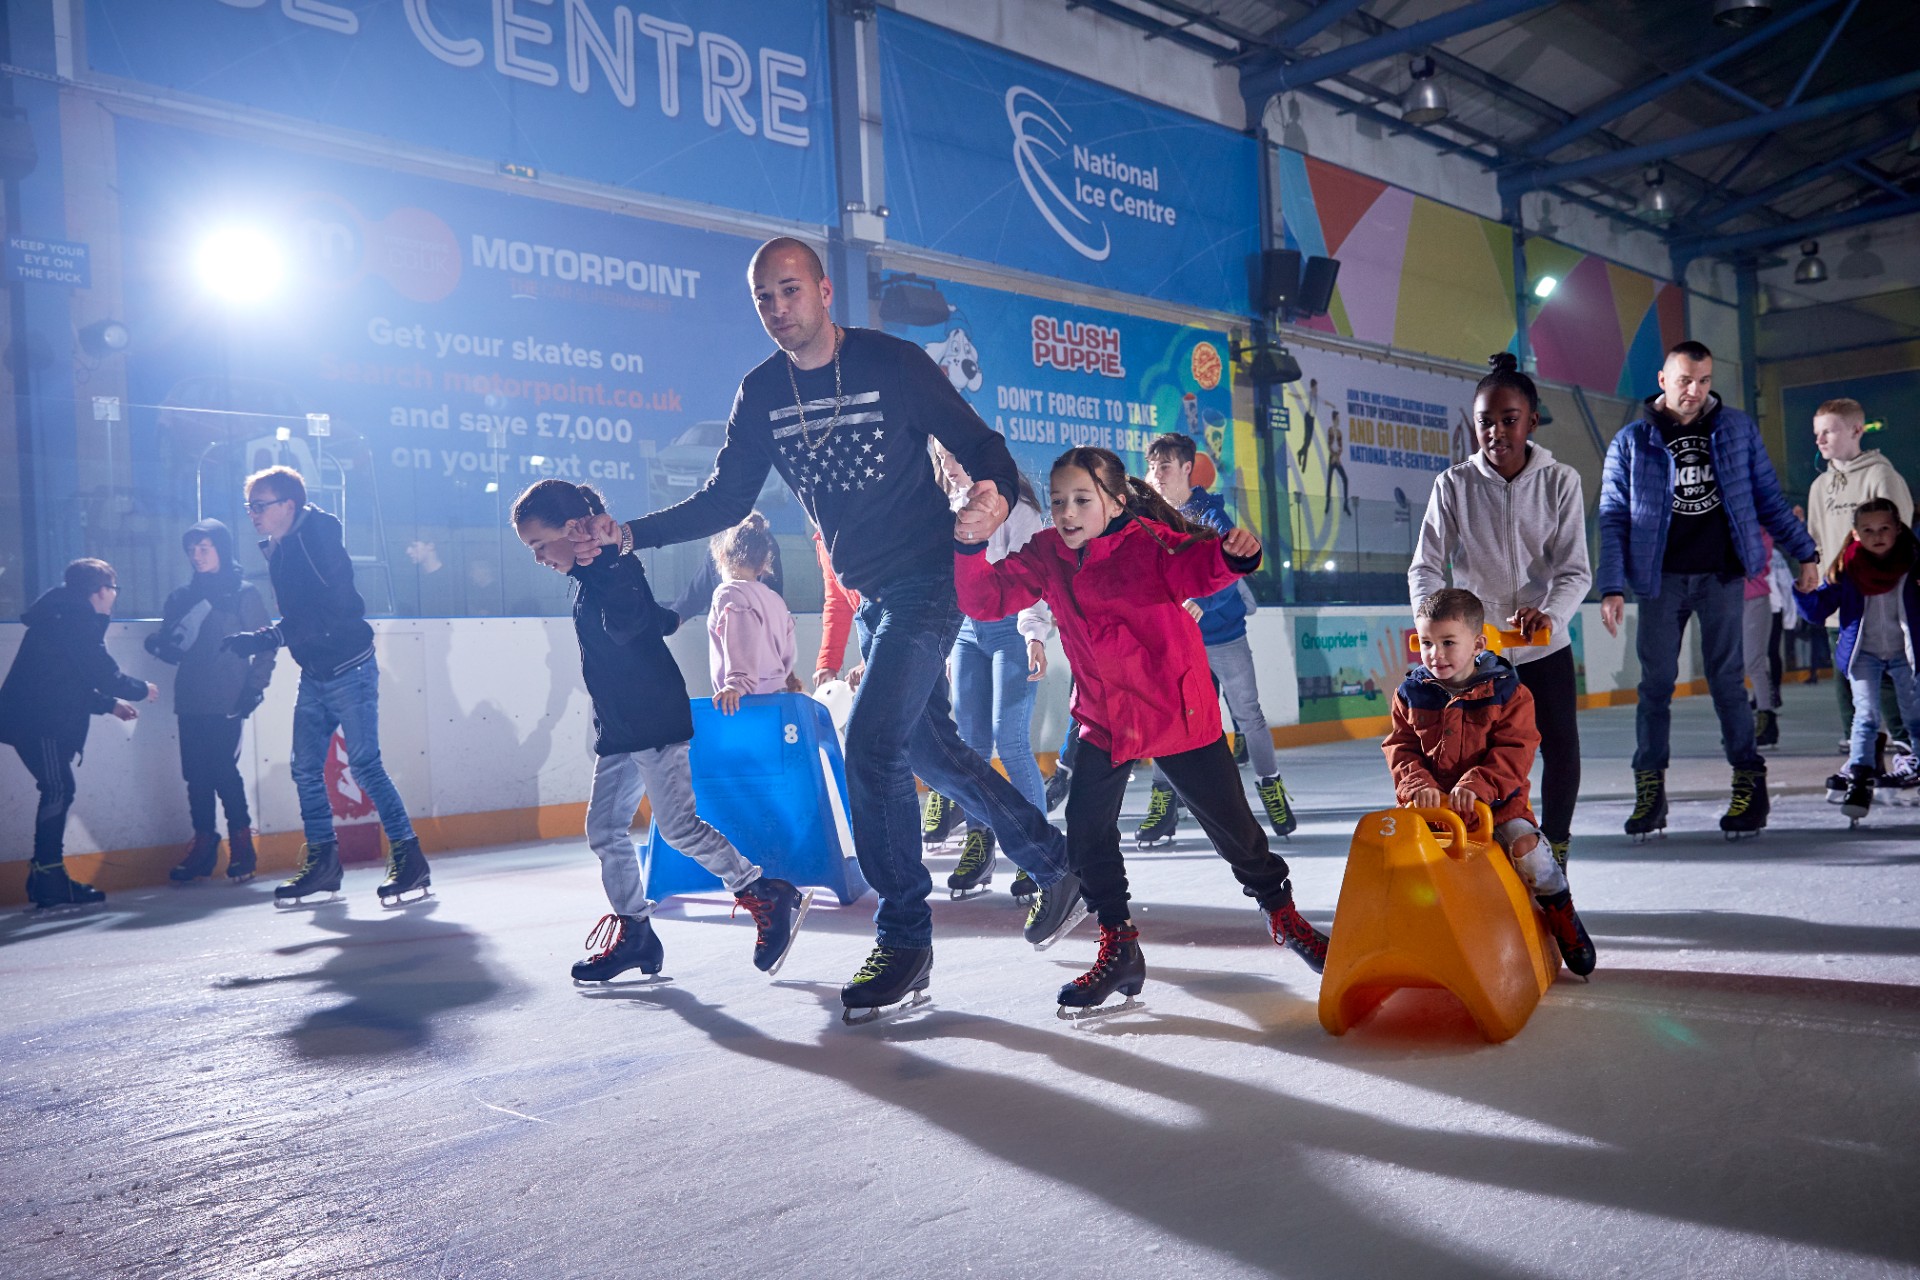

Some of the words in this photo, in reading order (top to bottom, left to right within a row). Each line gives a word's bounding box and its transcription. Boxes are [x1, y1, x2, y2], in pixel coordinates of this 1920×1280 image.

[403, 0, 811, 148] CENTRE
[1072, 144, 1160, 192] National
[1074, 177, 1106, 208] Ice
[1109, 187, 1177, 226] Centre
[11, 238, 45, 251] KEEP
[48, 243, 85, 258] YOUR
[24, 254, 50, 266] EYE
[53, 258, 73, 269] ON
[17, 266, 43, 279] THE
[47, 270, 82, 284] PUCK
[472, 234, 701, 299] MOTORPOINT
[367, 316, 426, 350] Get
[434, 330, 503, 358] your
[512, 336, 604, 369] skates
[610, 352, 644, 374] on
[1032, 318, 1119, 352] SLUSH
[319, 351, 434, 391] Search
[443, 371, 683, 412] motorpoint.co.uk
[997, 385, 1044, 414] DON'T
[1048, 392, 1101, 420] FORGET
[1105, 399, 1123, 423] TO
[1127, 402, 1158, 427] TAKE
[390, 404, 449, 430] and
[459, 411, 528, 436] save
[536, 412, 633, 444] £7,000
[995, 415, 1005, 437] A
[1009, 417, 1056, 444] SLUSH
[1060, 423, 1112, 450] PUPPIE
[1349, 417, 1374, 445] AND
[1377, 421, 1394, 448] GO
[1396, 424, 1419, 452] FOR
[1421, 428, 1450, 456] GOLD
[391, 446, 432, 469] on
[440, 450, 510, 477] your
[519, 453, 582, 477] next
[588, 458, 636, 480] car.
[1683, 485, 1706, 497] 1992
[1301, 632, 1359, 652] Grouprider
[784, 723, 799, 744] 8
[1380, 816, 1396, 836] 3
